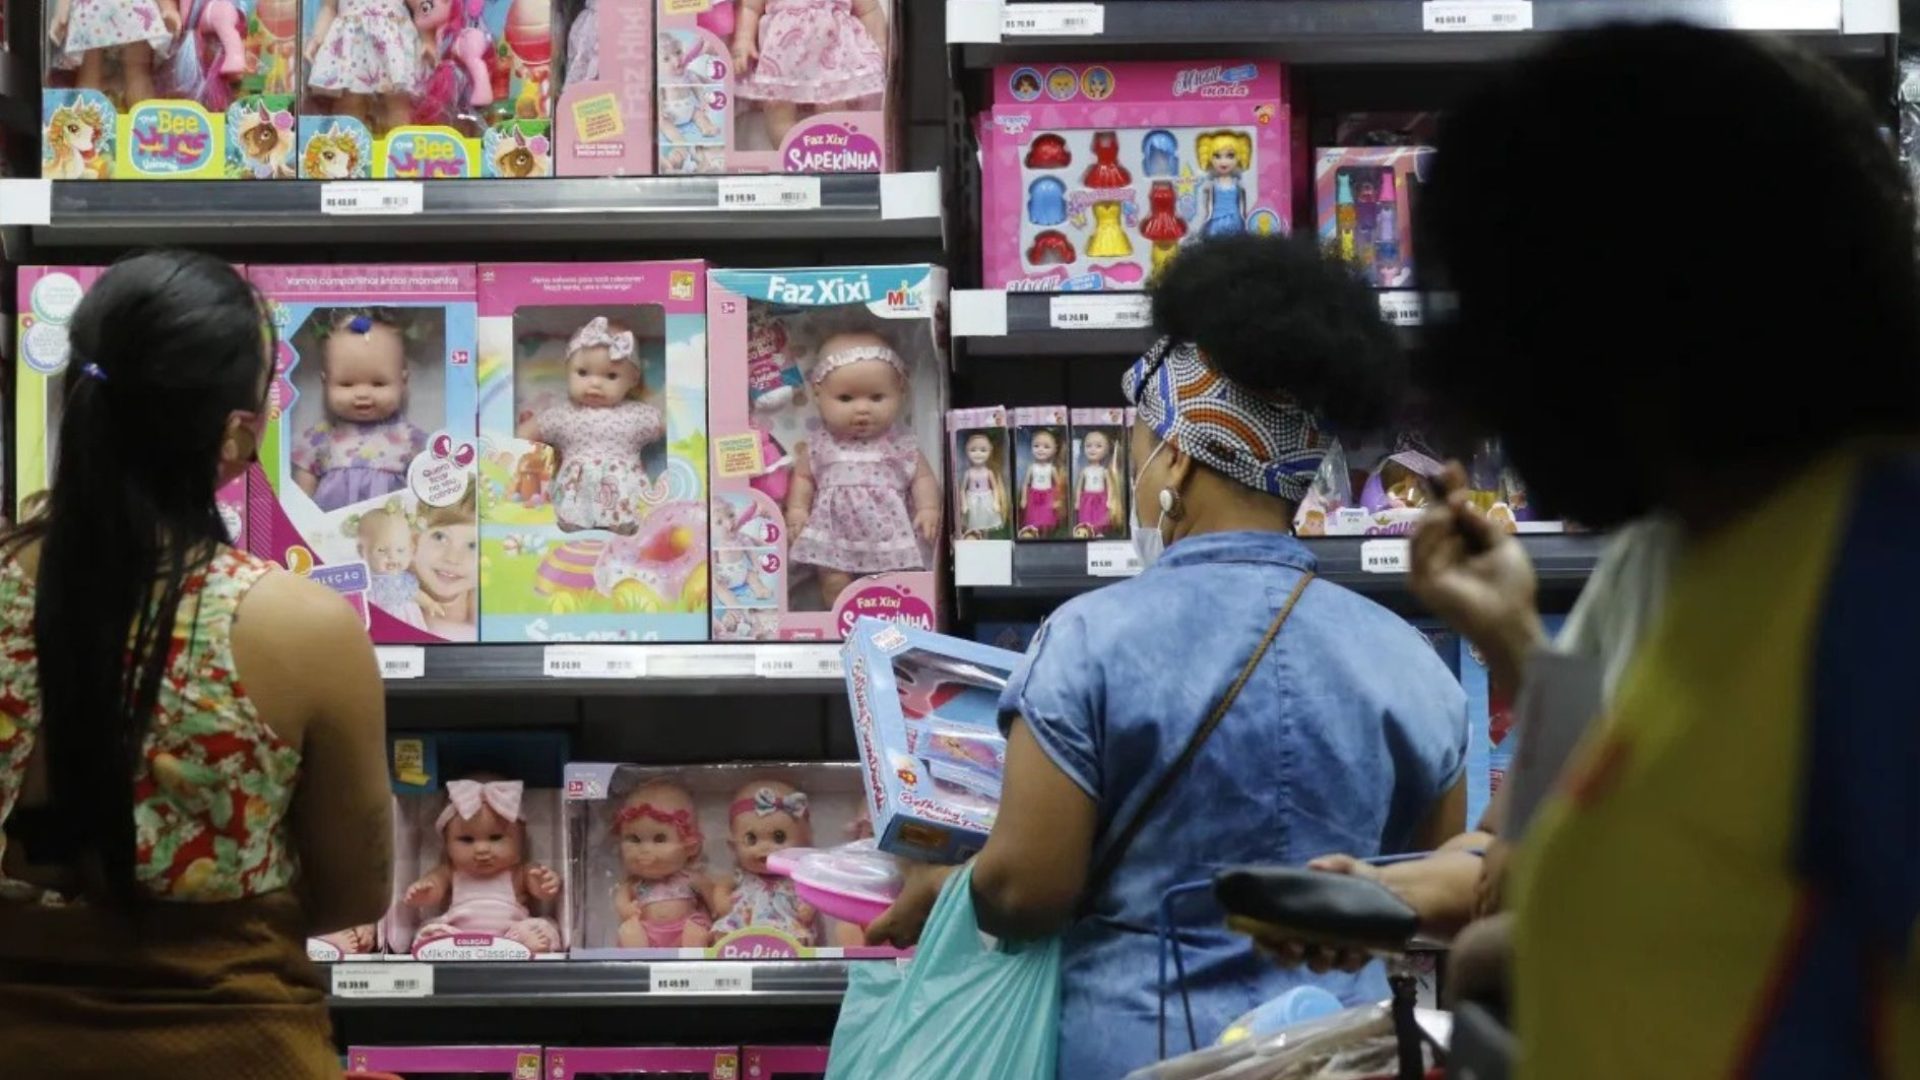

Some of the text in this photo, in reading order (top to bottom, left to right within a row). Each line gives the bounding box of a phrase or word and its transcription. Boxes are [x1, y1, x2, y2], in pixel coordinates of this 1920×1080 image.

[157, 109, 199, 134] Bee
[413, 135, 455, 159] Bee
[803, 135, 824, 147] Faz
[786, 147, 879, 172] SAPEKINHA
[766, 273, 872, 304] Faz Xixi
[313, 570, 360, 586] OLEÇÃO
[856, 597, 878, 609] Faz
